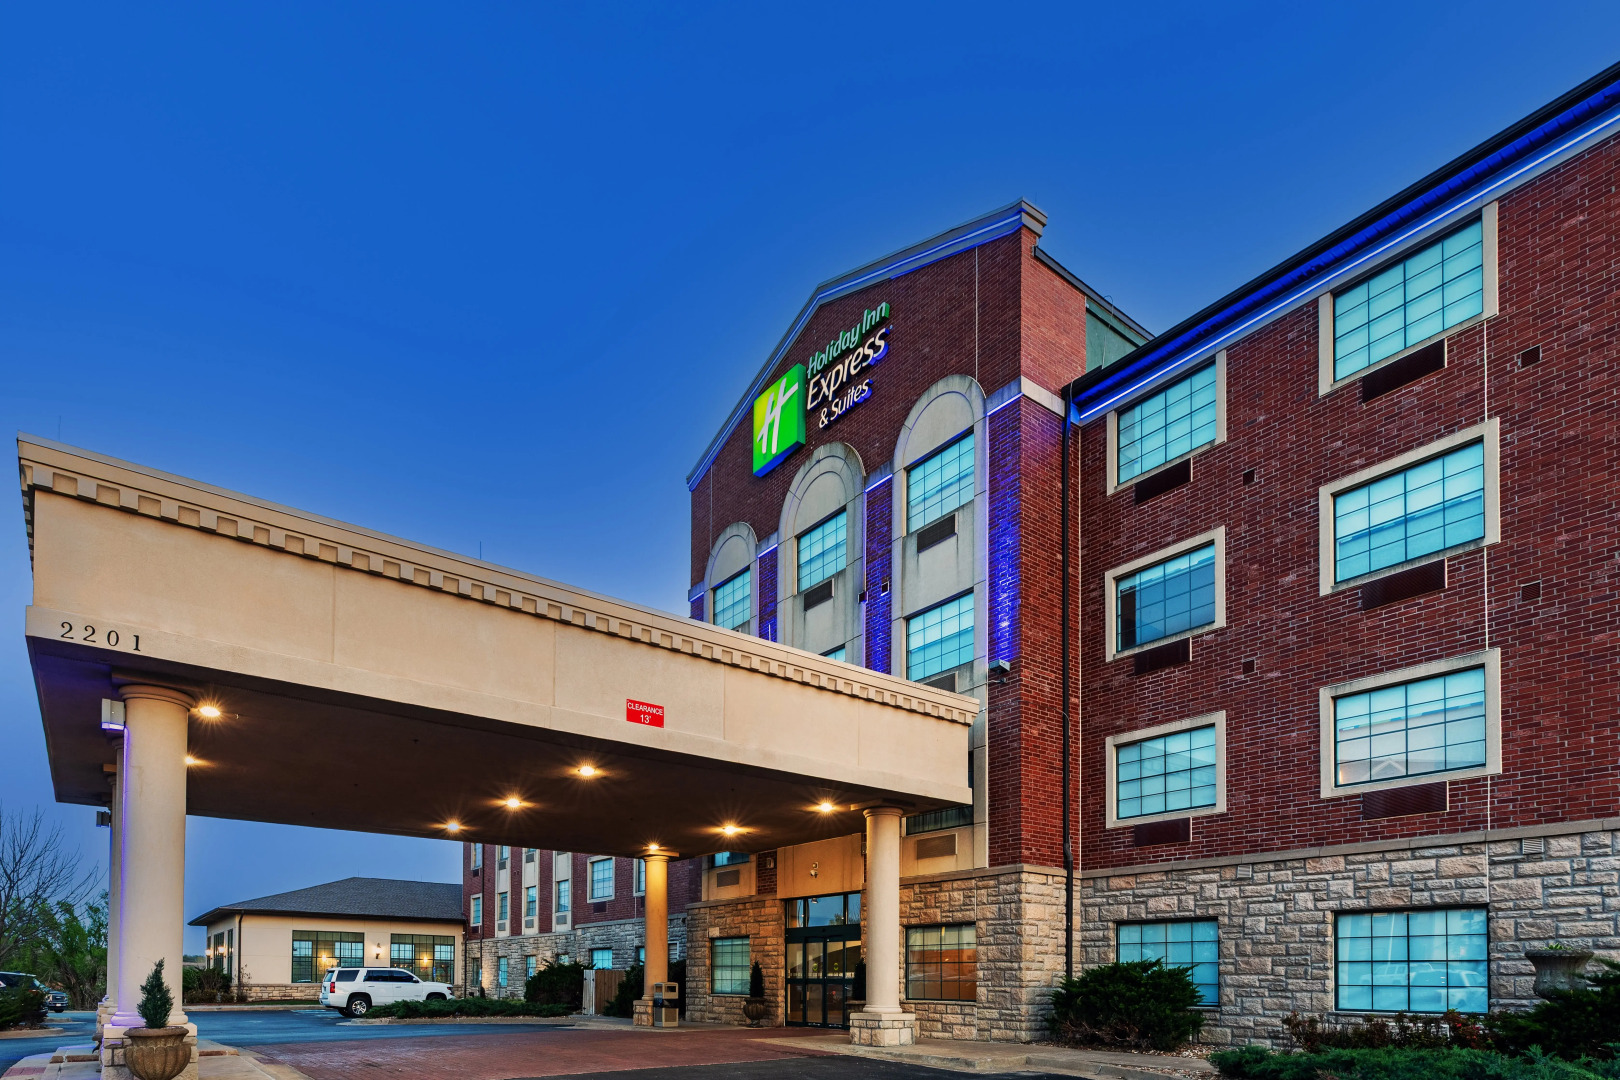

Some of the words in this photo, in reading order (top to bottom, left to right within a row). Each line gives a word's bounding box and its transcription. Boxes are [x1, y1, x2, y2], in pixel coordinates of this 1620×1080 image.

[807, 323, 862, 379] Holiday
[862, 302, 886, 334] Inn
[807, 328, 887, 410] Express
[819, 407, 829, 428] &
[830, 378, 871, 420] Suites
[60, 621, 141, 652] 2201
[627, 702, 664, 716] CLEARANCE
